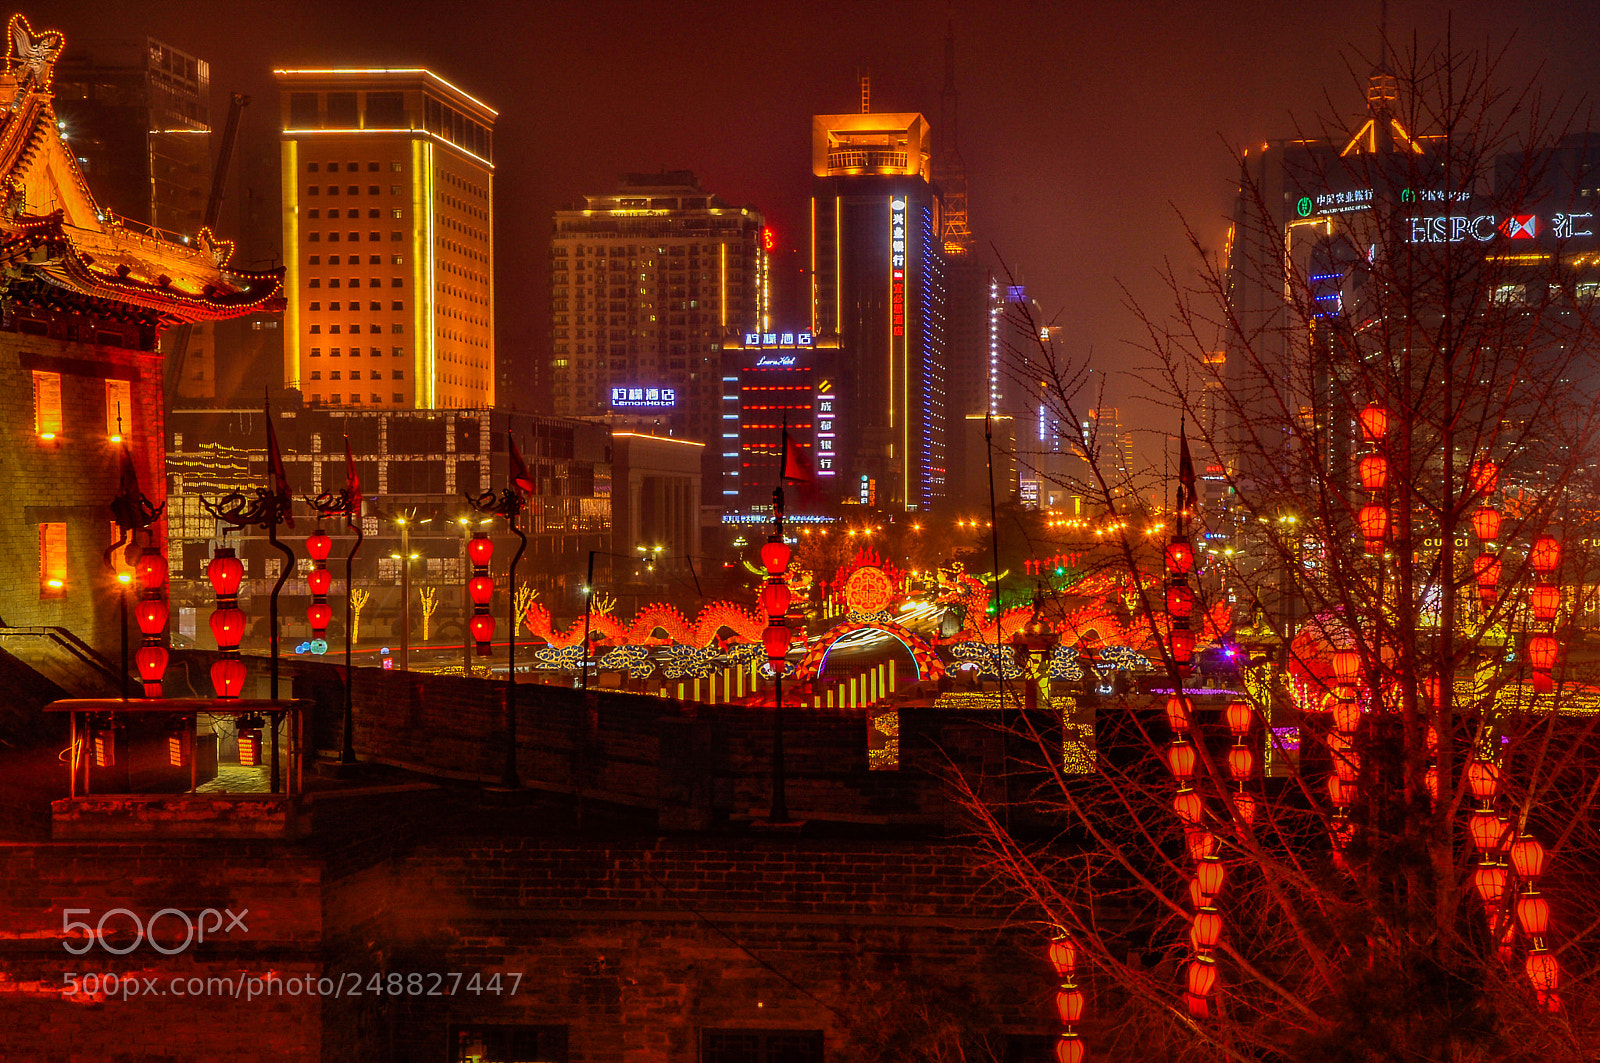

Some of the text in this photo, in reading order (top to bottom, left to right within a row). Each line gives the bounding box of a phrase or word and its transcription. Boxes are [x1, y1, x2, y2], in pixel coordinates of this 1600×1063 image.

[1405, 215, 1495, 243] HSBC
[1552, 212, 1593, 239] 汇
[892, 213, 905, 267] 兴业银行
[745, 333, 811, 345] 柠檬酒店
[612, 388, 675, 401] 柠檬酒店
[820, 401, 832, 469] 成都银行
[1423, 538, 1469, 547] GUCI
